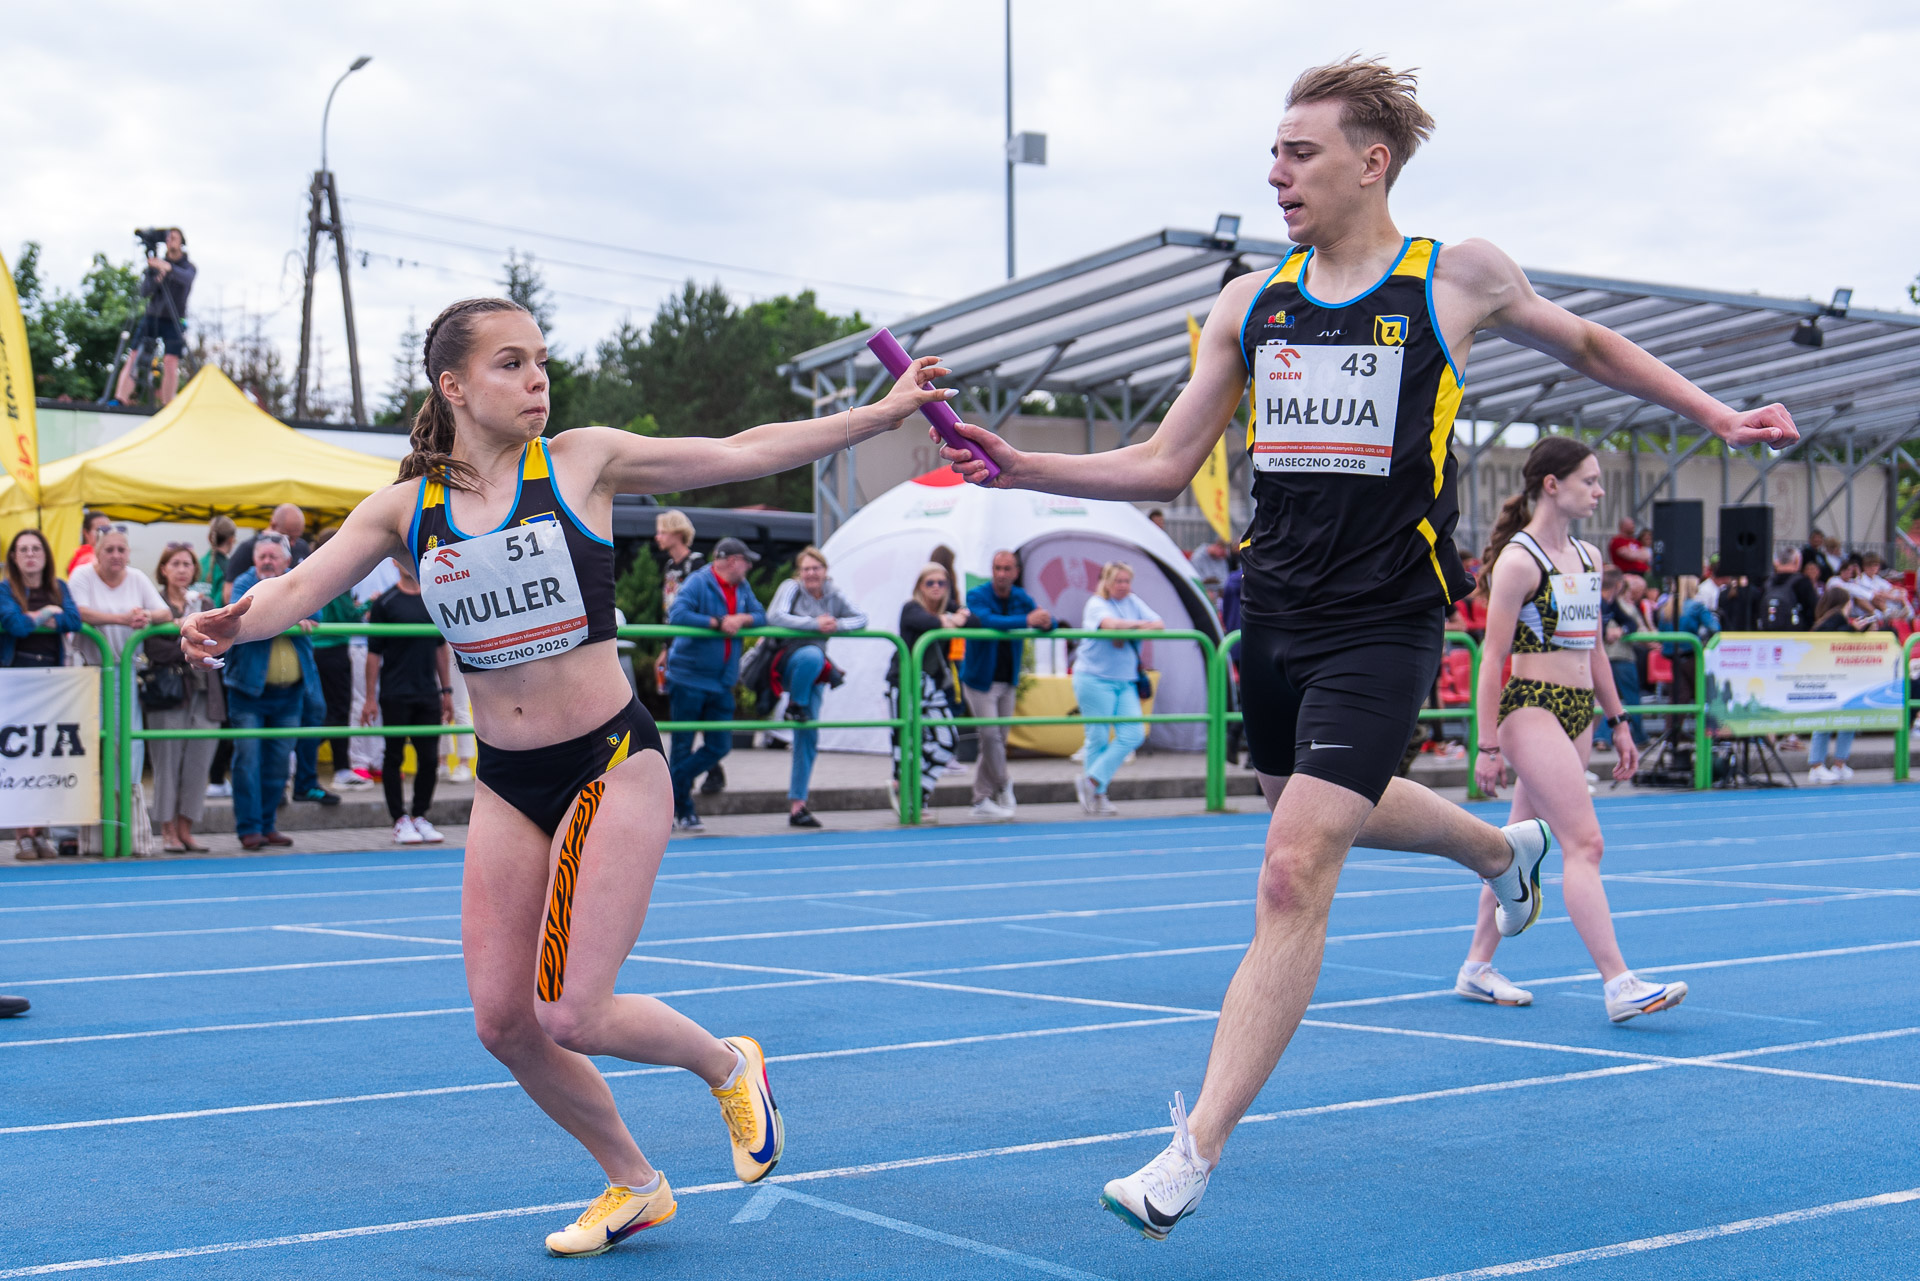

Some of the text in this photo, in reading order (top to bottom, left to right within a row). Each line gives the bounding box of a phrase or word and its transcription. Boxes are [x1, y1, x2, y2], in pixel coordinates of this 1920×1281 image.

[1269, 371, 1302, 381] ORLEN
[1340, 352, 1378, 377] 43
[1266, 397, 1379, 427] HAŁUJA
[1268, 457, 1366, 470] PIASECZNO 2026
[505, 531, 545, 562] 51
[434, 569, 471, 585] ORLEN
[438, 576, 567, 629] MULLER
[523, 628, 552, 640] Mieszanych
[469, 637, 569, 665] PIASECZNO 2026
